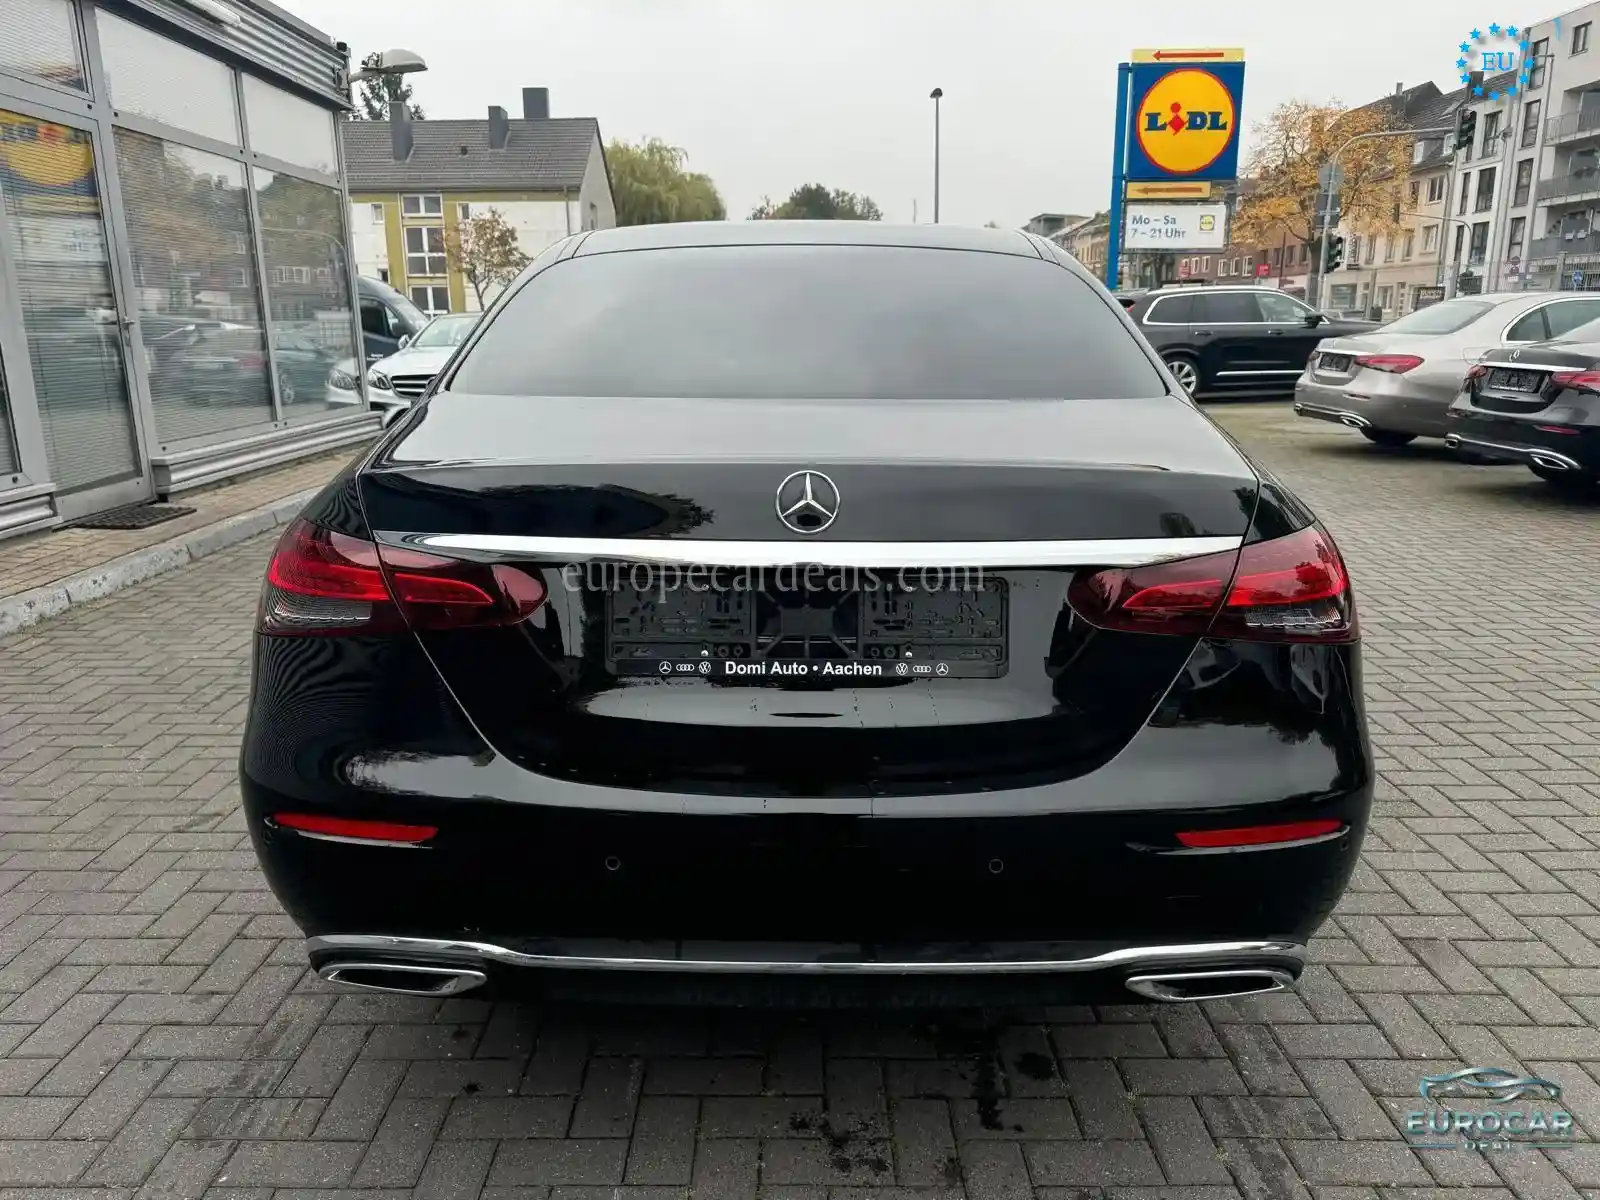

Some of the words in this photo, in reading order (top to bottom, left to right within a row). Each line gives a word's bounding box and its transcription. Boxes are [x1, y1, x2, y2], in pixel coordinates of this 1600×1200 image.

[1132, 214, 1150, 225] Mo
[1163, 215, 1177, 225] Sa
[1130, 228, 1138, 239] 7
[1149, 228, 1162, 239] 21
[1164, 227, 1187, 239] Uhr
[725, 661, 766, 675] Domi
[770, 661, 809, 675] Auto
[822, 661, 882, 676] Aachen
